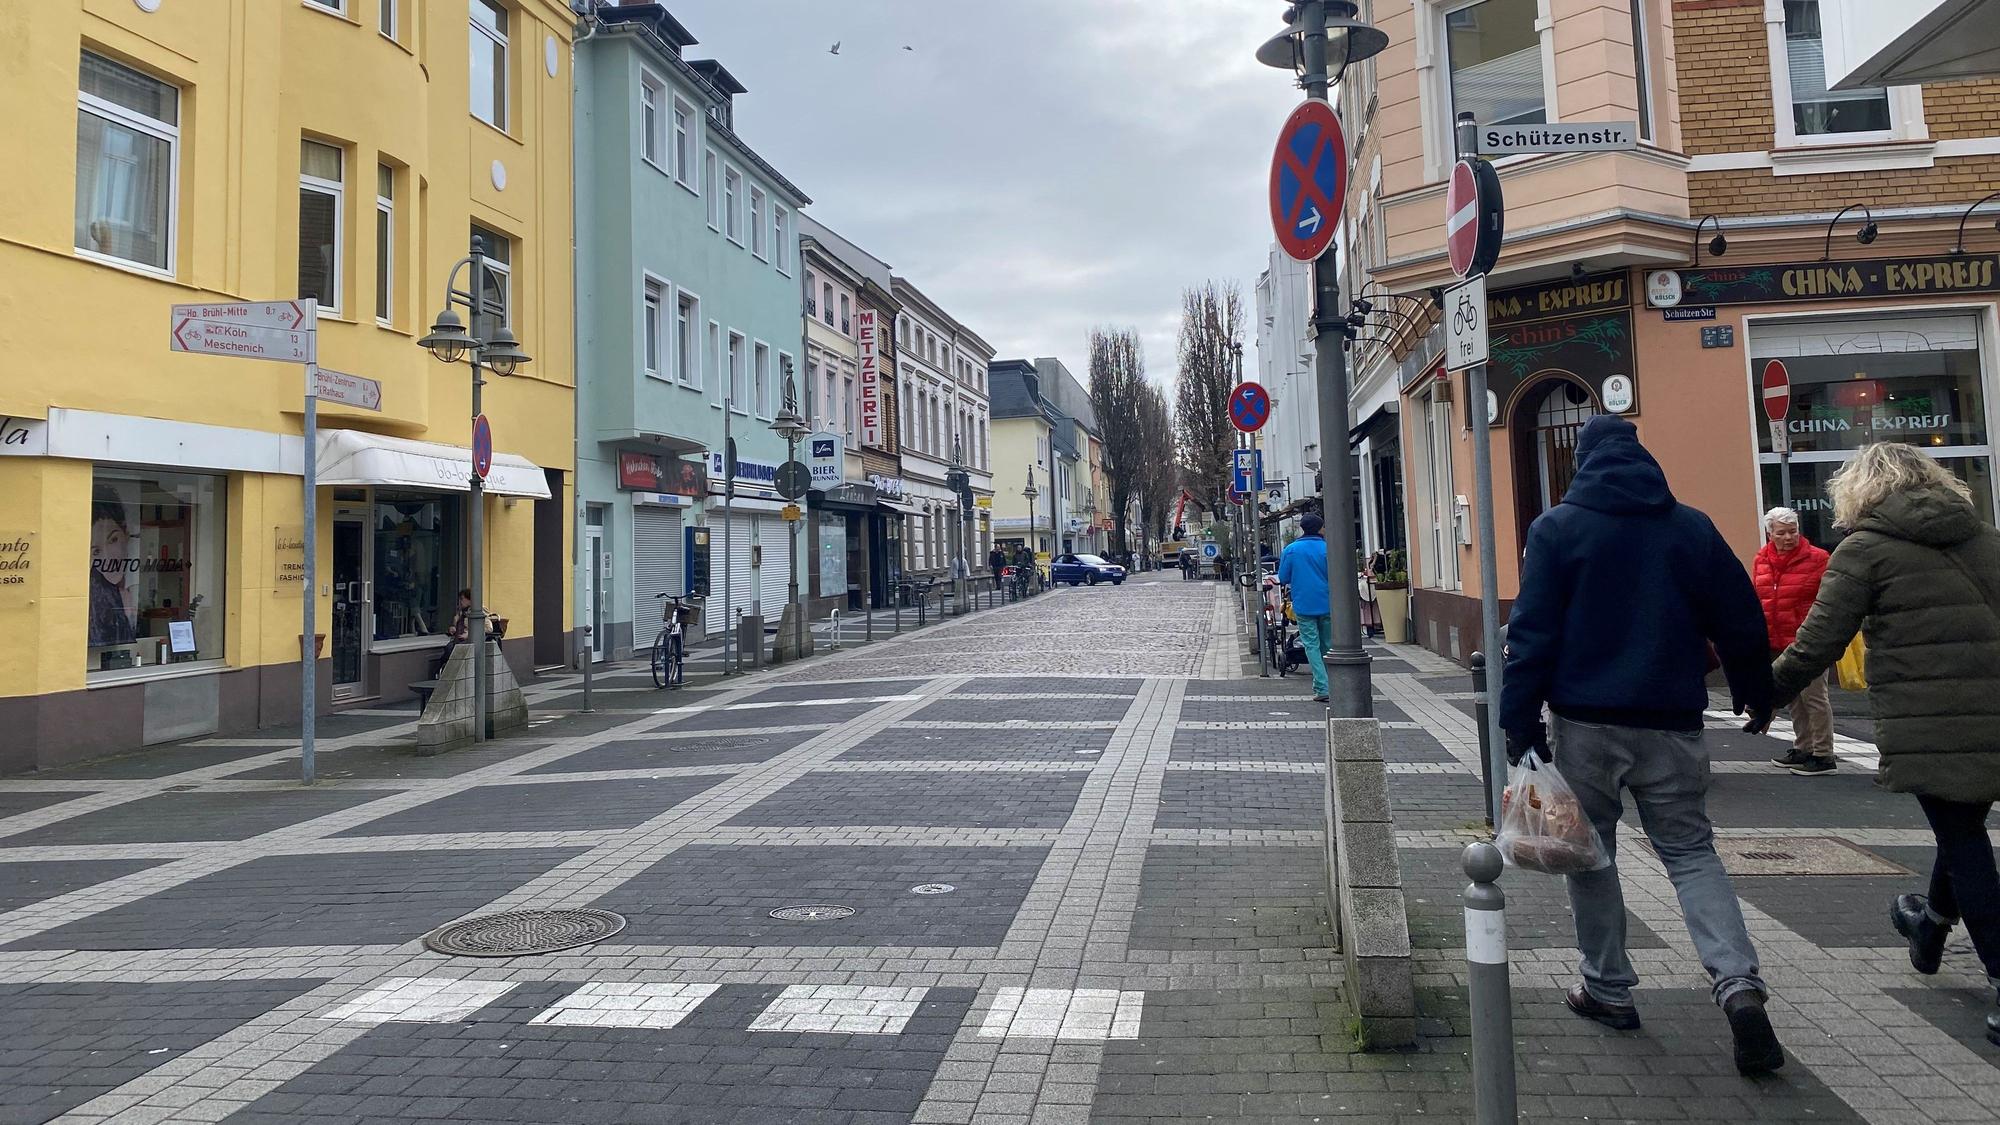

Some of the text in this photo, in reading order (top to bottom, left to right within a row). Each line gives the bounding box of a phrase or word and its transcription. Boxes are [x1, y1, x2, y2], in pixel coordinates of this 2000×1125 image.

[1487, 128, 1627, 148] Schützenstr.
[1781, 260, 1994, 296] CHINA EXPRESS
[1488, 279, 1624, 321] INA EXPRESS
[202, 306, 248, 318] Brühl-Mitte
[224, 326, 299, 344] Köln 13
[1510, 320, 1577, 346] chin's
[204, 338, 264, 353] Meschenich
[1460, 337, 1474, 358] frei
[860, 312, 877, 442] METZGEREI
[1788, 414, 1950, 433] CHINA EXPRESS
[813, 465, 835, 475] BIER
[1791, 498, 1833, 511] HIN
[0, 537, 29, 552] nto
[0, 552, 30, 570] oda
[91, 557, 185, 573] PUNTO MODA
[0, 574, 24, 584] SÖR
